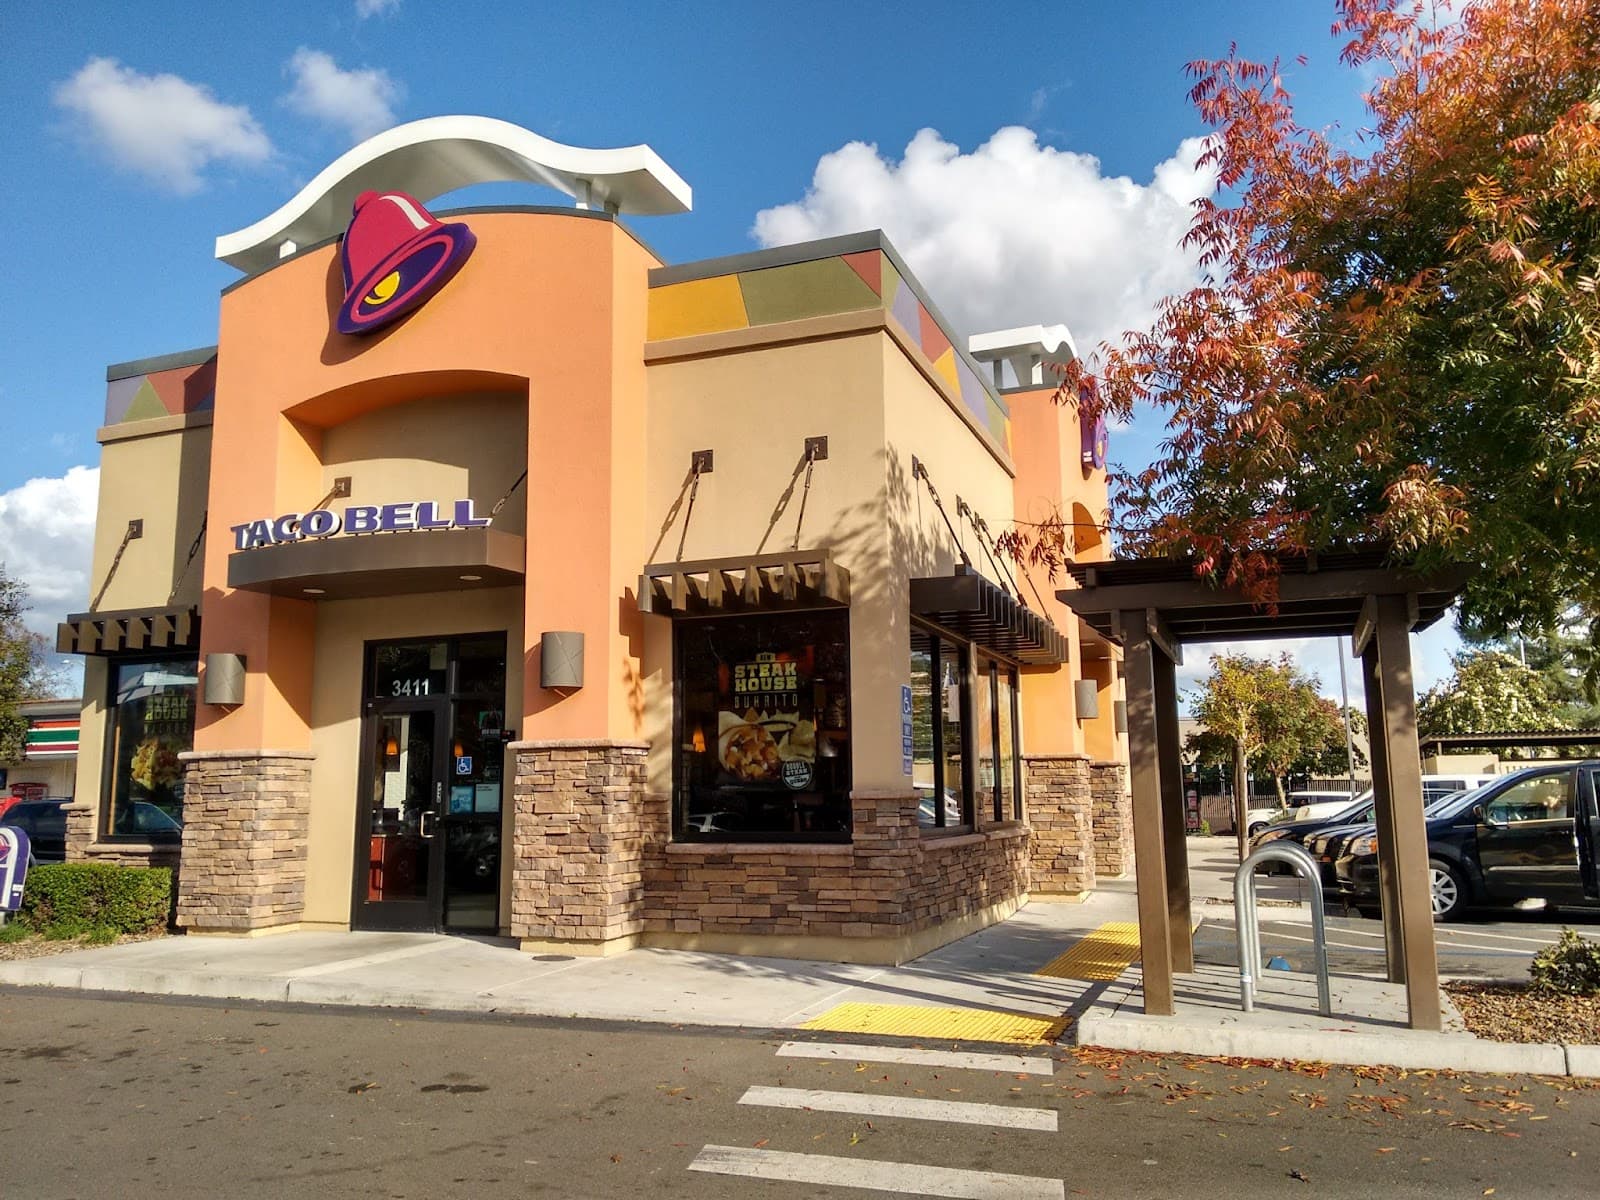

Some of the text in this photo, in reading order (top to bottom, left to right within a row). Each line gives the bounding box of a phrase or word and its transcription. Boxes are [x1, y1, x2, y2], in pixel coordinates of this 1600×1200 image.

[230, 499, 493, 551] TACO BELL
[735, 662, 797, 678] STEAK
[392, 678, 429, 697] 3411
[735, 676, 797, 692] HOUSE
[734, 693, 798, 709] BURRITO
